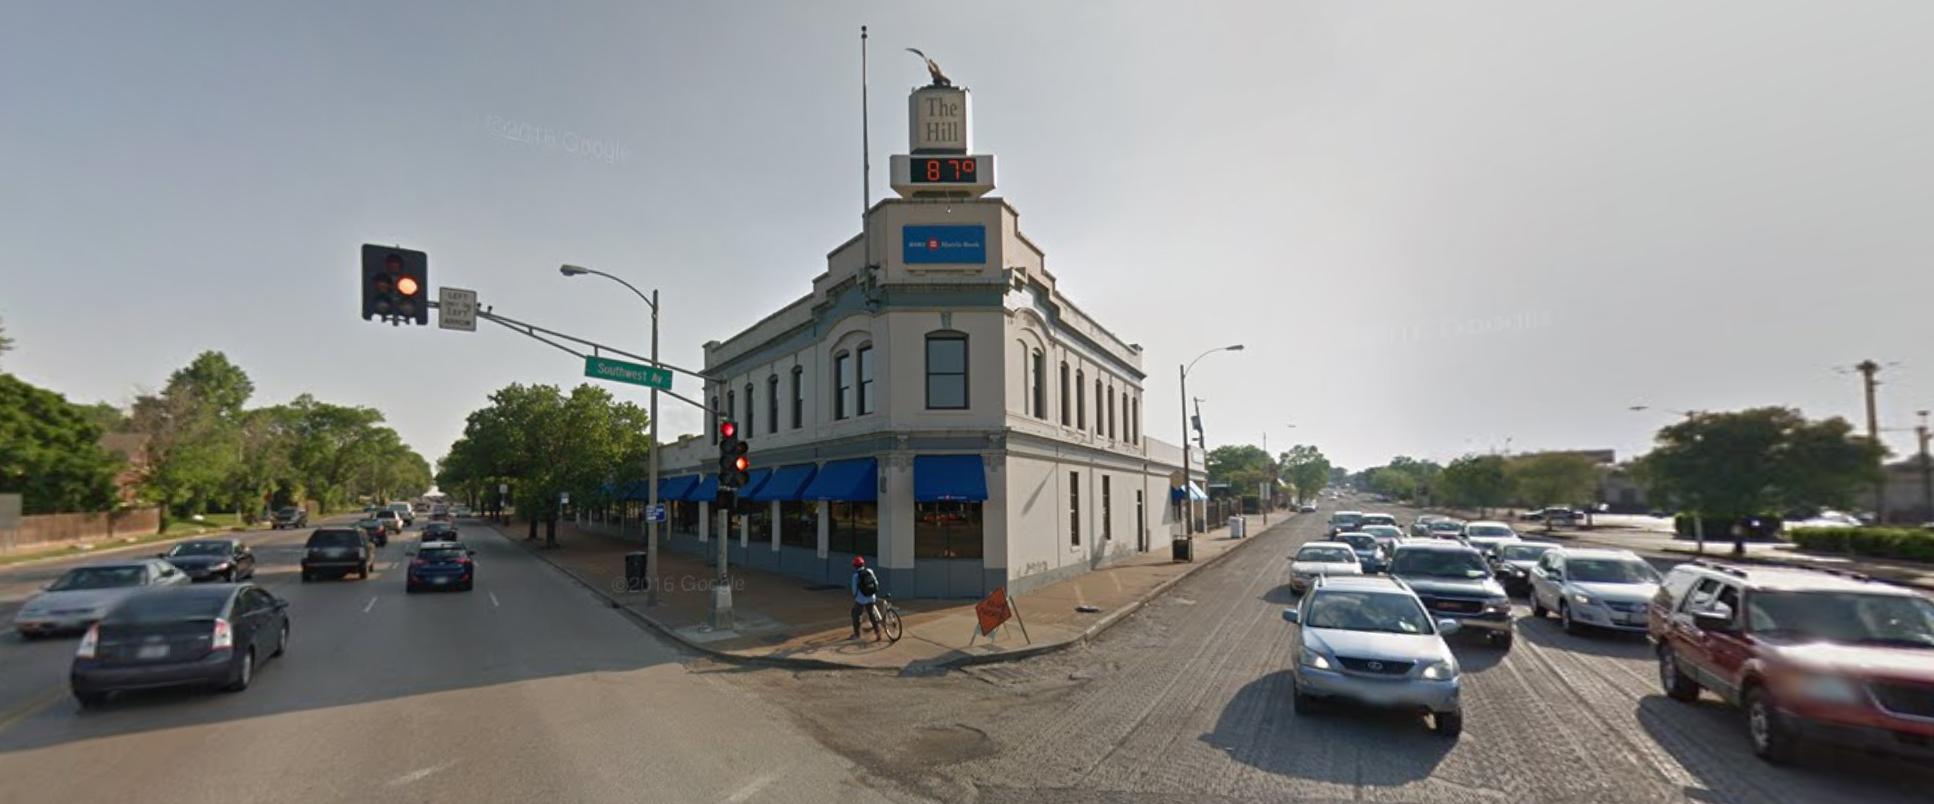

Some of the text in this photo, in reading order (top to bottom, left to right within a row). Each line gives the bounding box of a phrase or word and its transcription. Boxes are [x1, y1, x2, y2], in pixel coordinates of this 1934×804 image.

[925, 97, 958, 117] The
[926, 122, 958, 142] Hill
[447, 291, 468, 301] LEFT
[447, 307, 468, 317] LEFT
[597, 362, 663, 384] Southwest Av
